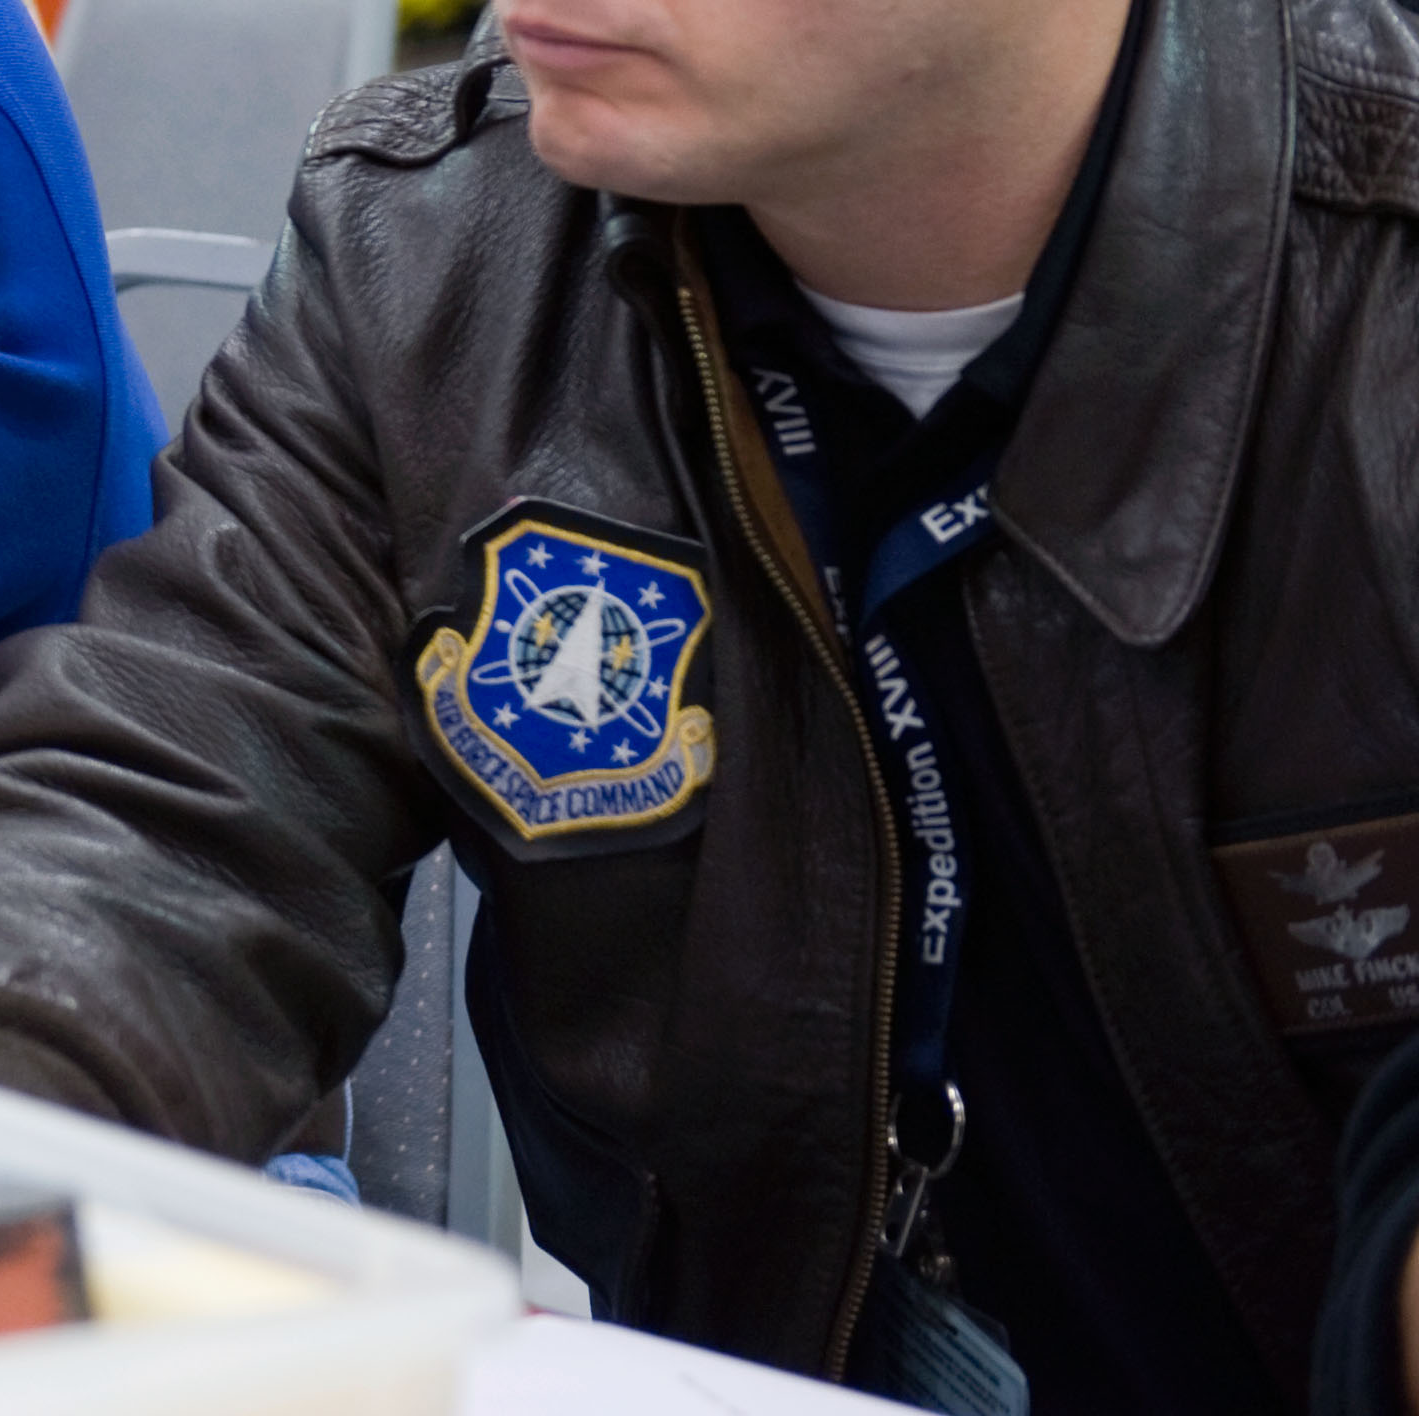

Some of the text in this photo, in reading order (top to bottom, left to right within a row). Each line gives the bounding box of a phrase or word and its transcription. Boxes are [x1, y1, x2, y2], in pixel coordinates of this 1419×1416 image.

[434, 686, 684, 825] AIR FORCE SPACE COMMAND
[864, 633, 962, 964] Expedition XVIII
